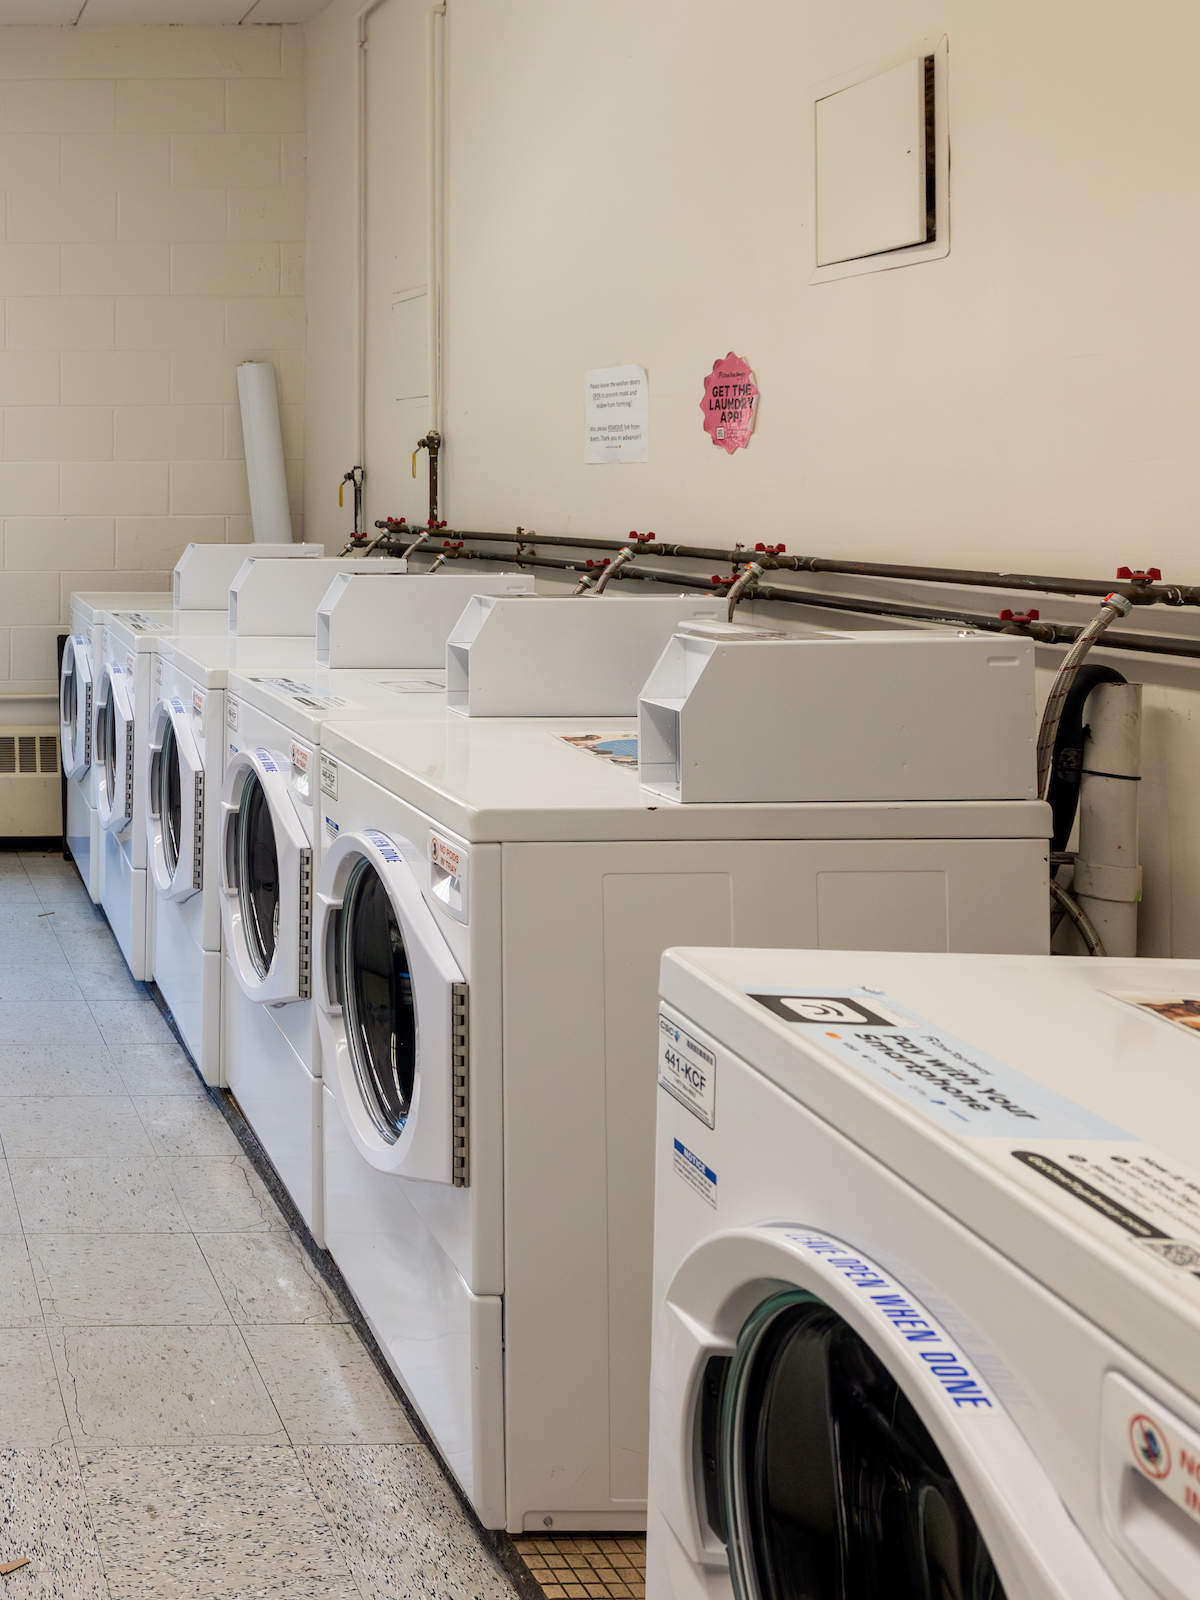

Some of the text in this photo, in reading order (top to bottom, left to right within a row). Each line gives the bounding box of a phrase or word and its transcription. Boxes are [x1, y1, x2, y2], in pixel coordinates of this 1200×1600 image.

[605, 391, 618, 399] prevent
[712, 384, 751, 397] GET THE
[709, 397, 754, 410] LAUNDRY
[720, 411, 743, 423] APP!
[446, 848, 459, 864] PODS
[660, 1020, 674, 1037] CSC
[665, 1049, 706, 1091] 441-KCF
[854, 1032, 991, 1113] Smartphone
[883, 1033, 929, 1058] Pay
[926, 1058, 980, 1086] with
[977, 1088, 1040, 1121] Your
[684, 1148, 707, 1175] NOTICE
[785, 1233, 995, 1409] LEAVE OPEN WHEN DONE
